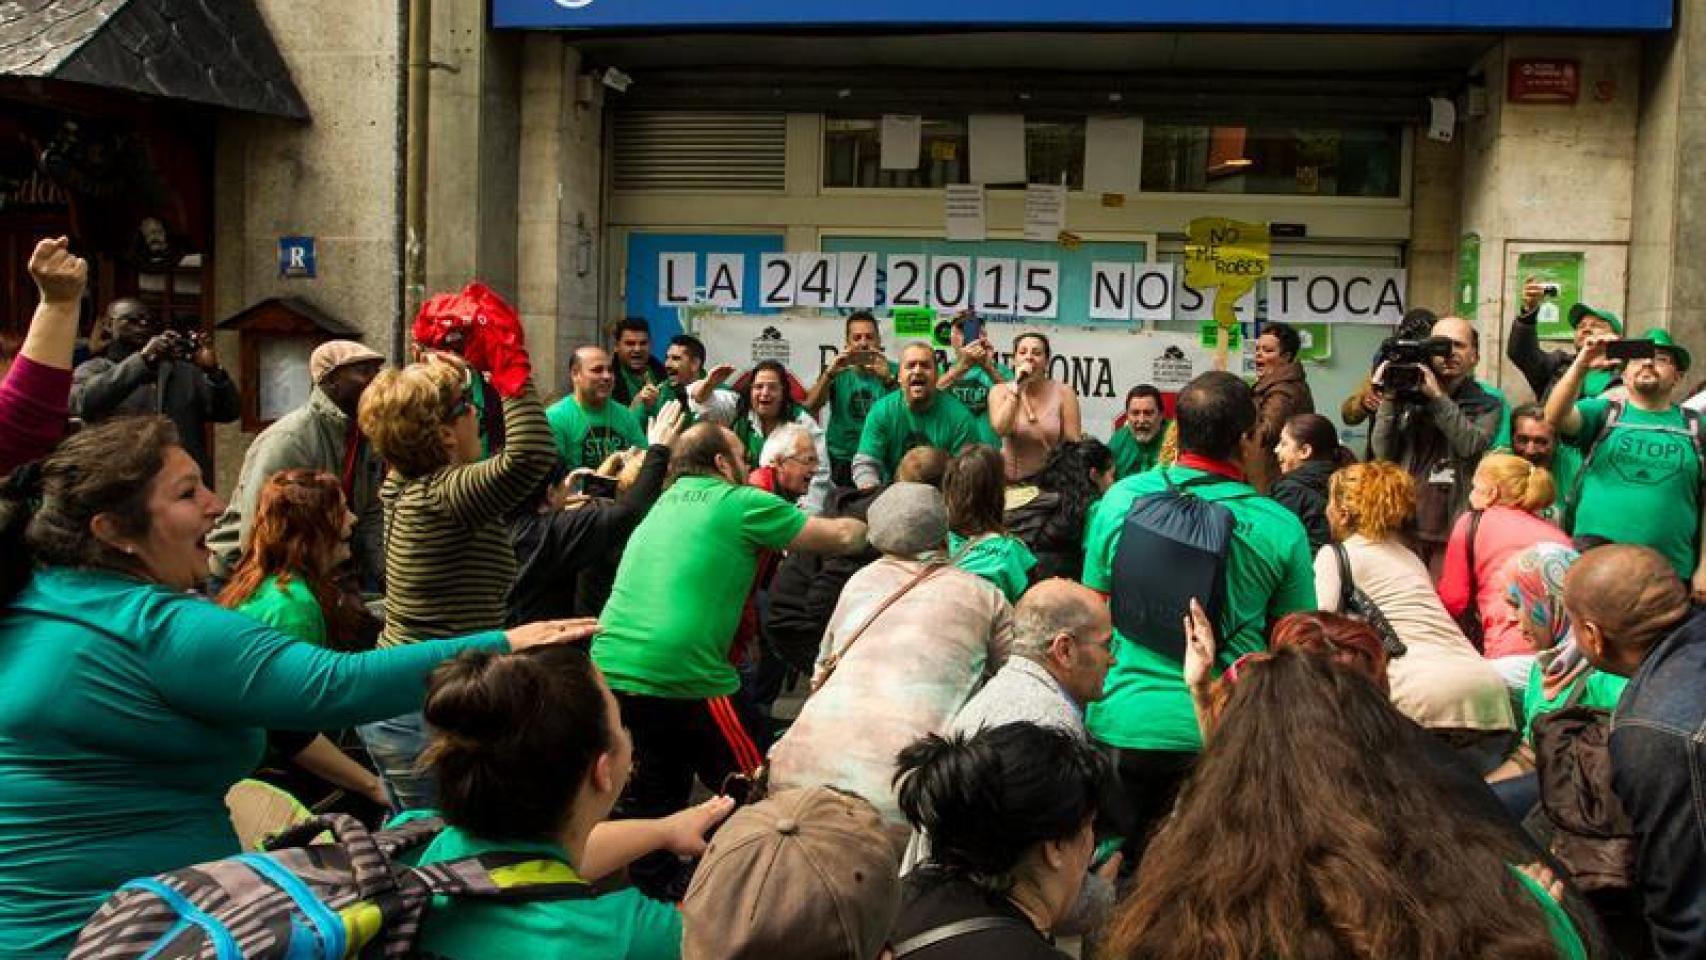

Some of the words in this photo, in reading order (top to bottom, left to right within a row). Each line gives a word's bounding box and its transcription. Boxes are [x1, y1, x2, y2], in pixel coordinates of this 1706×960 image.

[1210, 228, 1240, 243] NO
[290, 247, 305, 267] R
[1215, 258, 1265, 276] ROBES
[666, 259, 738, 302] LA
[765, 254, 1053, 313] 24/2015
[1270, 276, 1405, 316] TOCA
[1620, 437, 1680, 459] STOP
